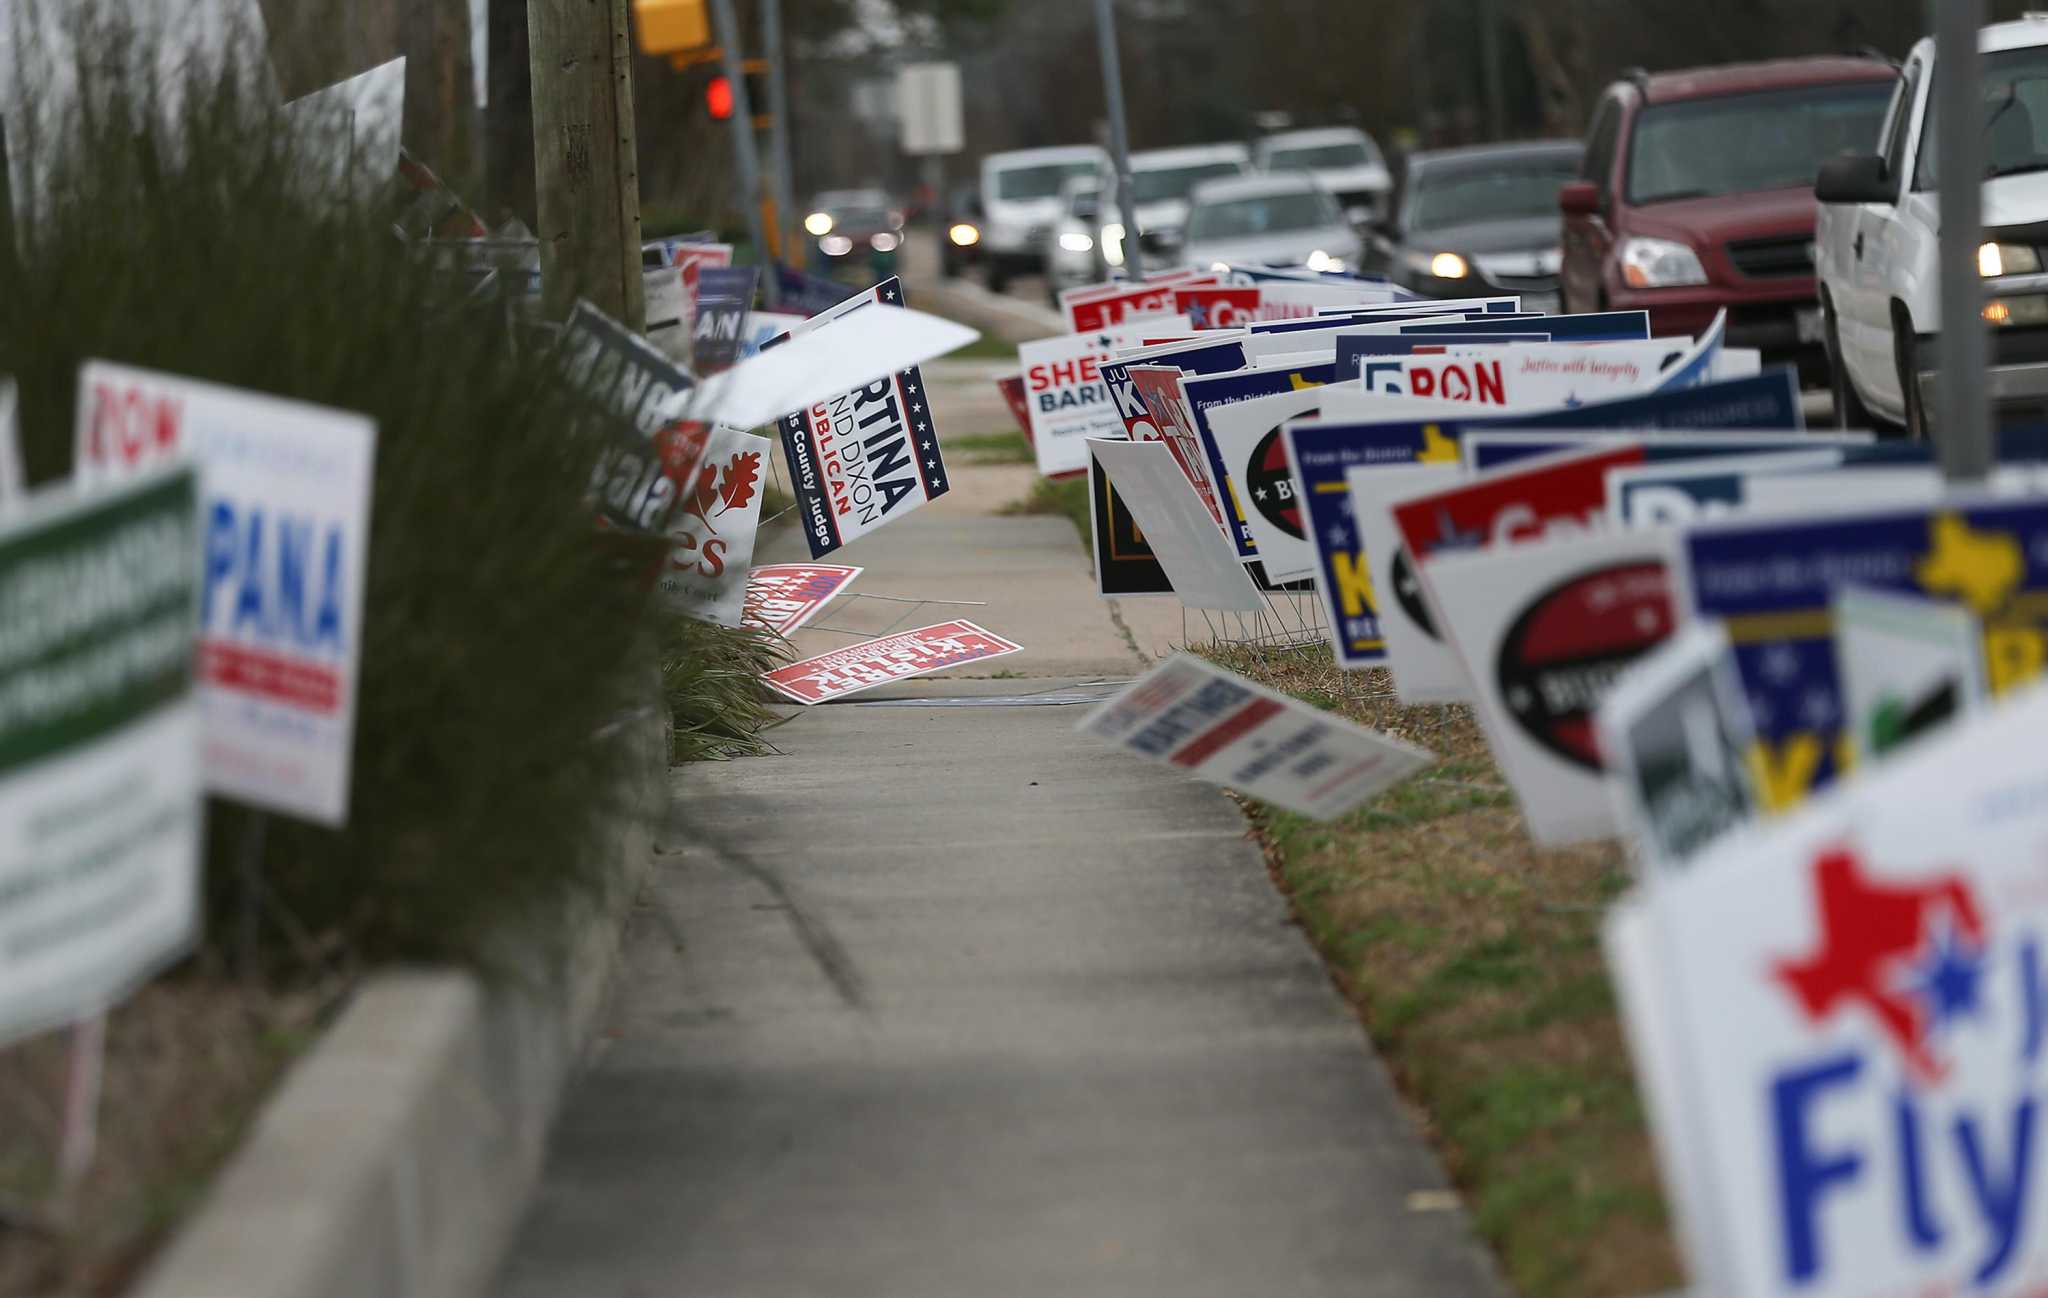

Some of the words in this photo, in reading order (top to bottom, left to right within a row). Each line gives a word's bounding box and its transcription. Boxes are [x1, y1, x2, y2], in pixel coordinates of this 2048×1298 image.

[1029, 354, 1109, 391] SHE
[1590, 360, 1640, 383] Integrity
[792, 429, 817, 491] County
[808, 495, 831, 547] Judge
[840, 439, 879, 526] DIXON
[806, 636, 966, 685] KISLUK
[814, 663, 922, 698] BRET
[1770, 1050, 2039, 1290] Fly
